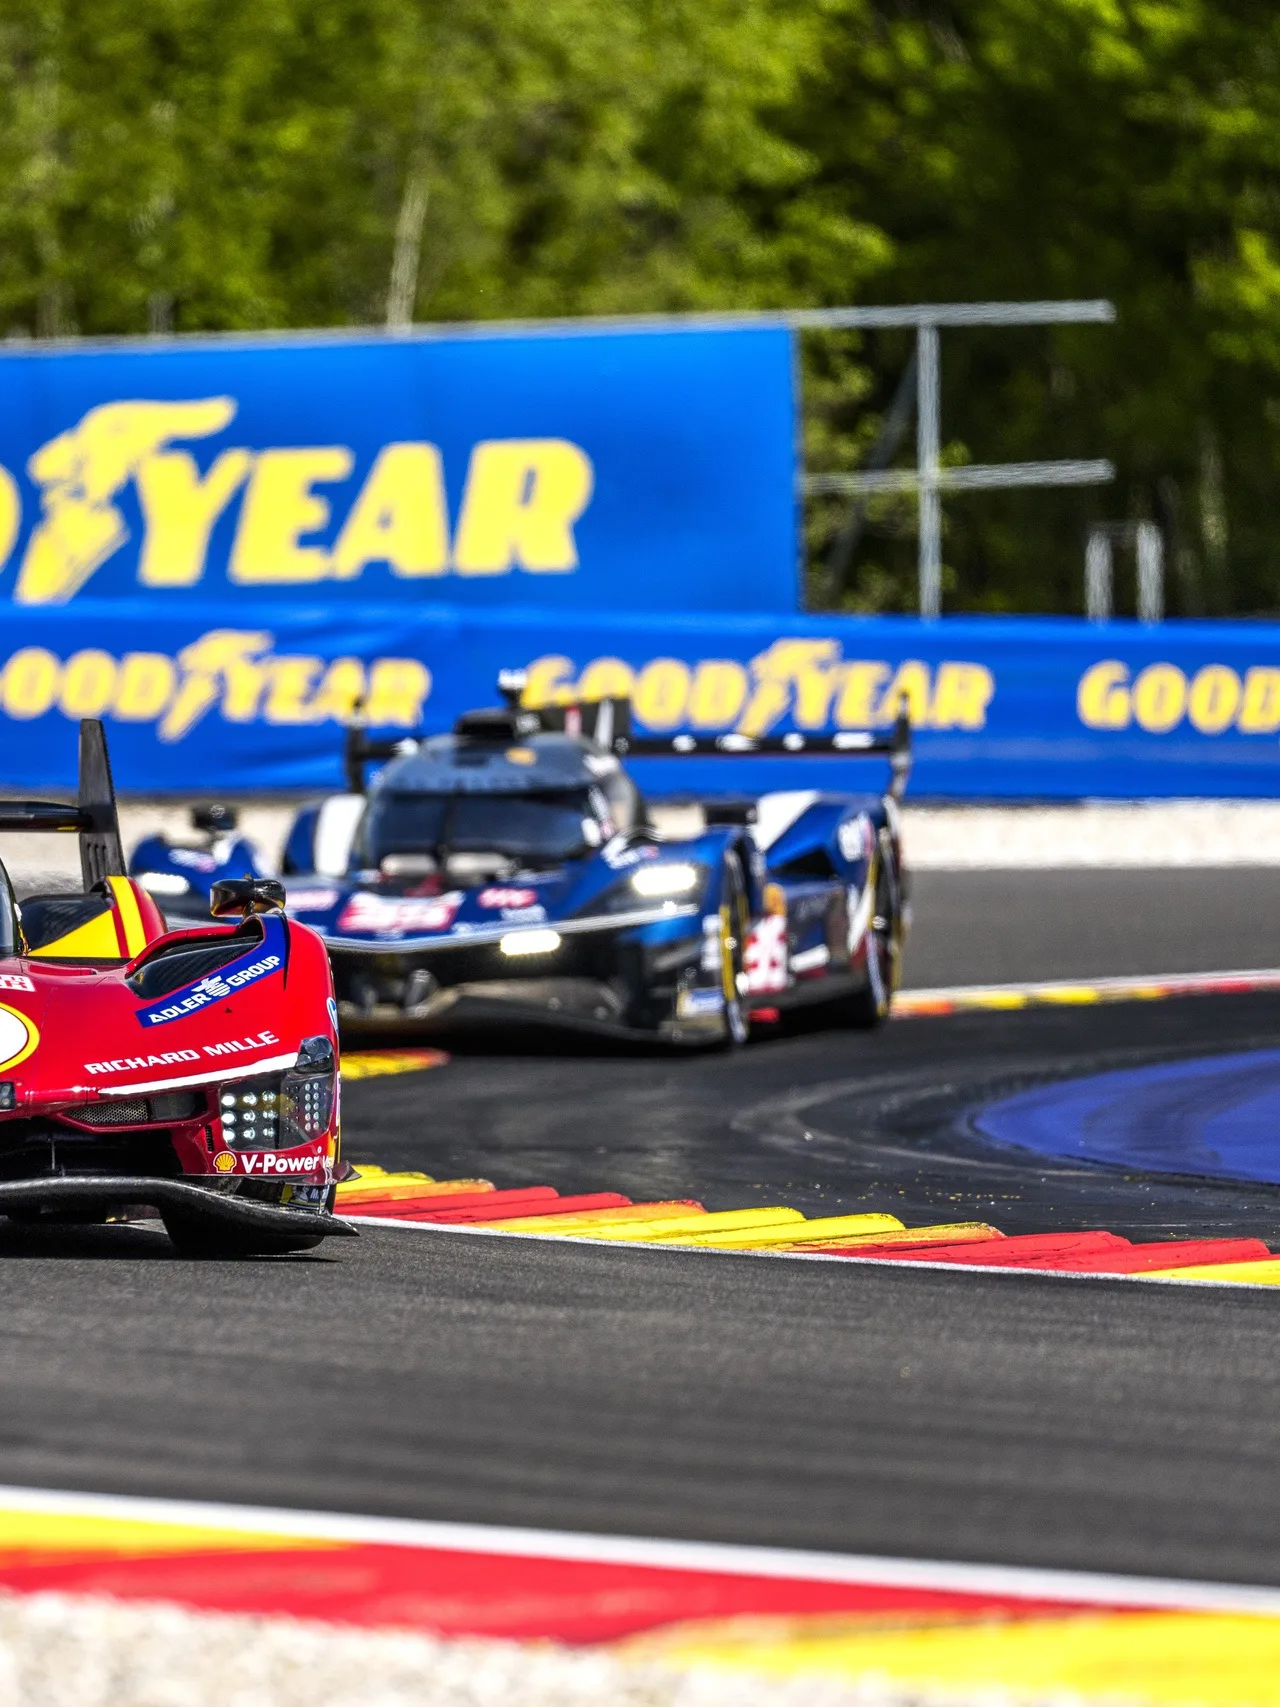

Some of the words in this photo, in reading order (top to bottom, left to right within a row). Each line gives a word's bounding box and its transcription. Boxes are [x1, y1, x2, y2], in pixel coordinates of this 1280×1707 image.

[148, 993, 212, 1023] ADLER
[225, 955, 280, 987] GROUP
[83, 1049, 200, 1075] RICHARD
[202, 1030, 280, 1057] MILLE
[241, 1153, 320, 1174] V-Power
